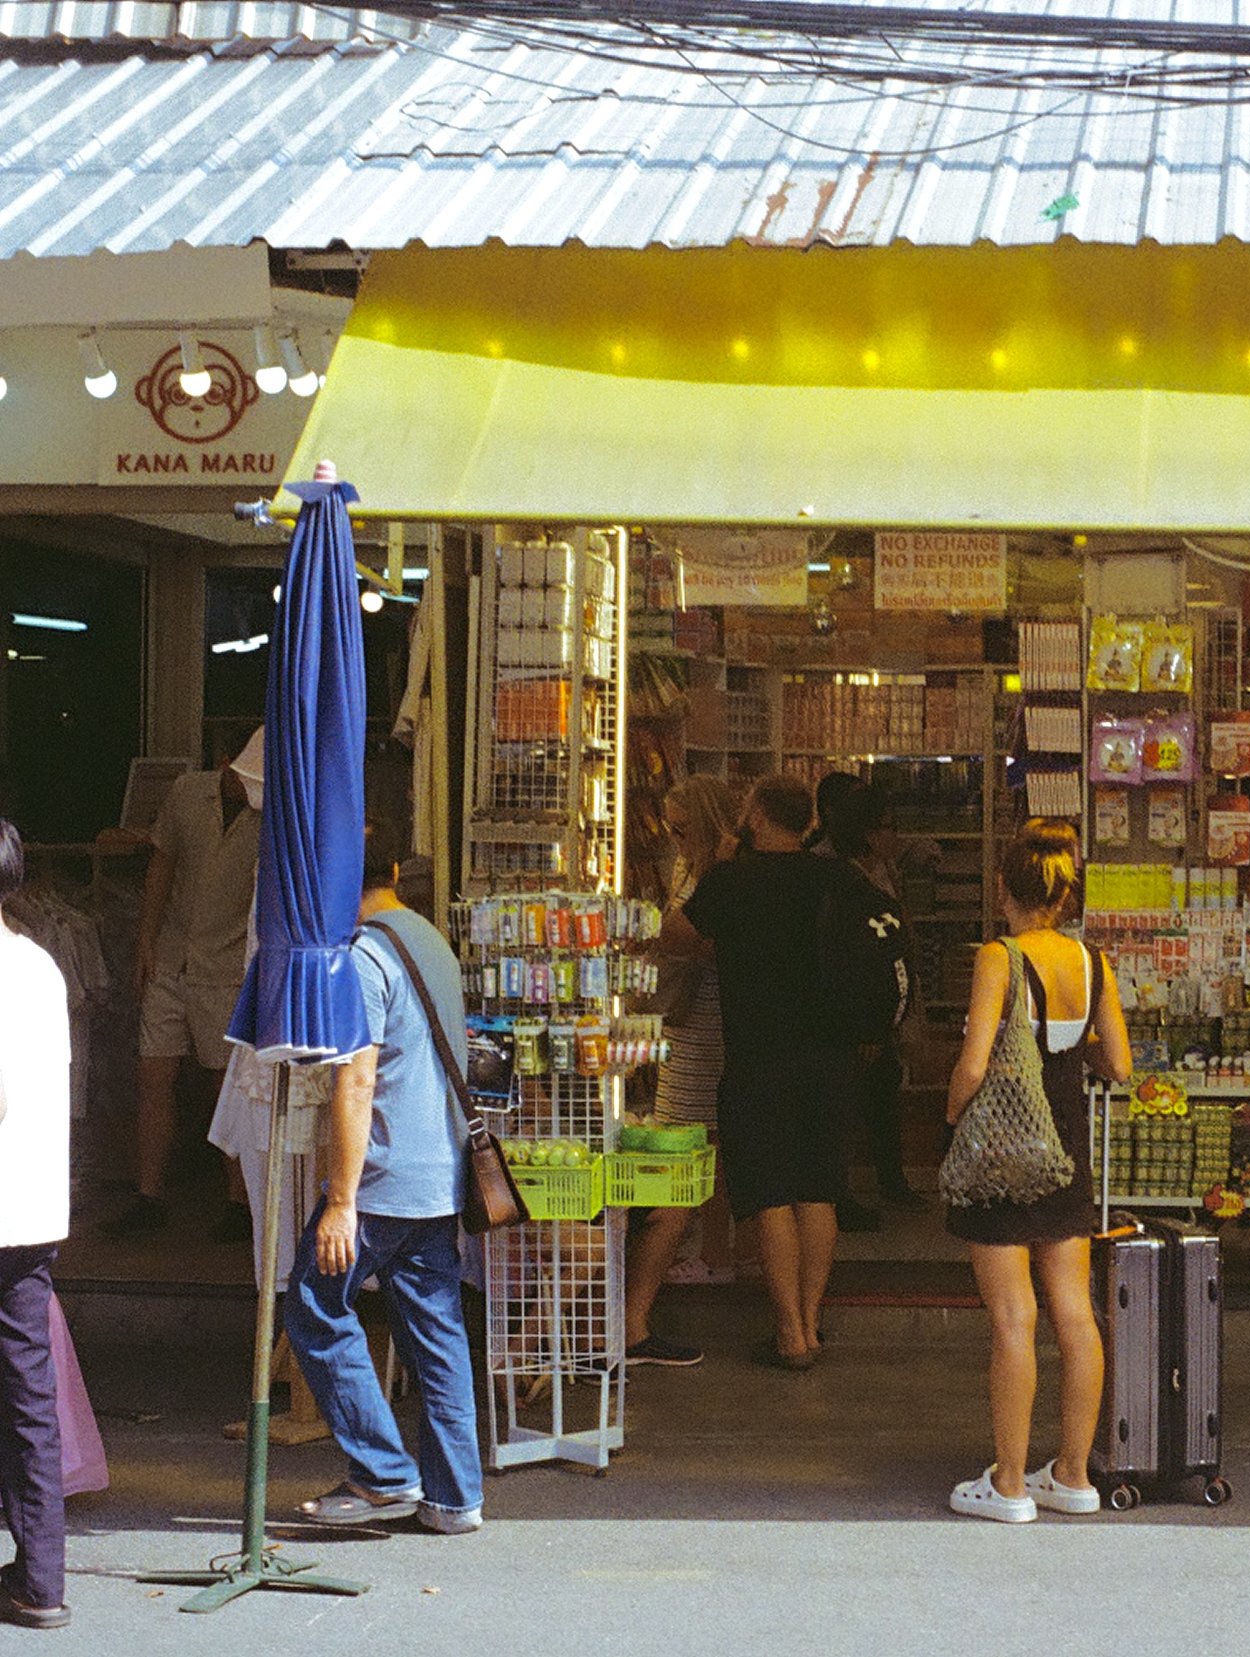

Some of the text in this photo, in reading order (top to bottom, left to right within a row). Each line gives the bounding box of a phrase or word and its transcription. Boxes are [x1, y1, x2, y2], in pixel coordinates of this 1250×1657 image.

[117, 453, 275, 473] KANA MARU
[880, 535, 1000, 552] NO EXCHANGE
[880, 553, 1000, 569] NO REFUNDS
